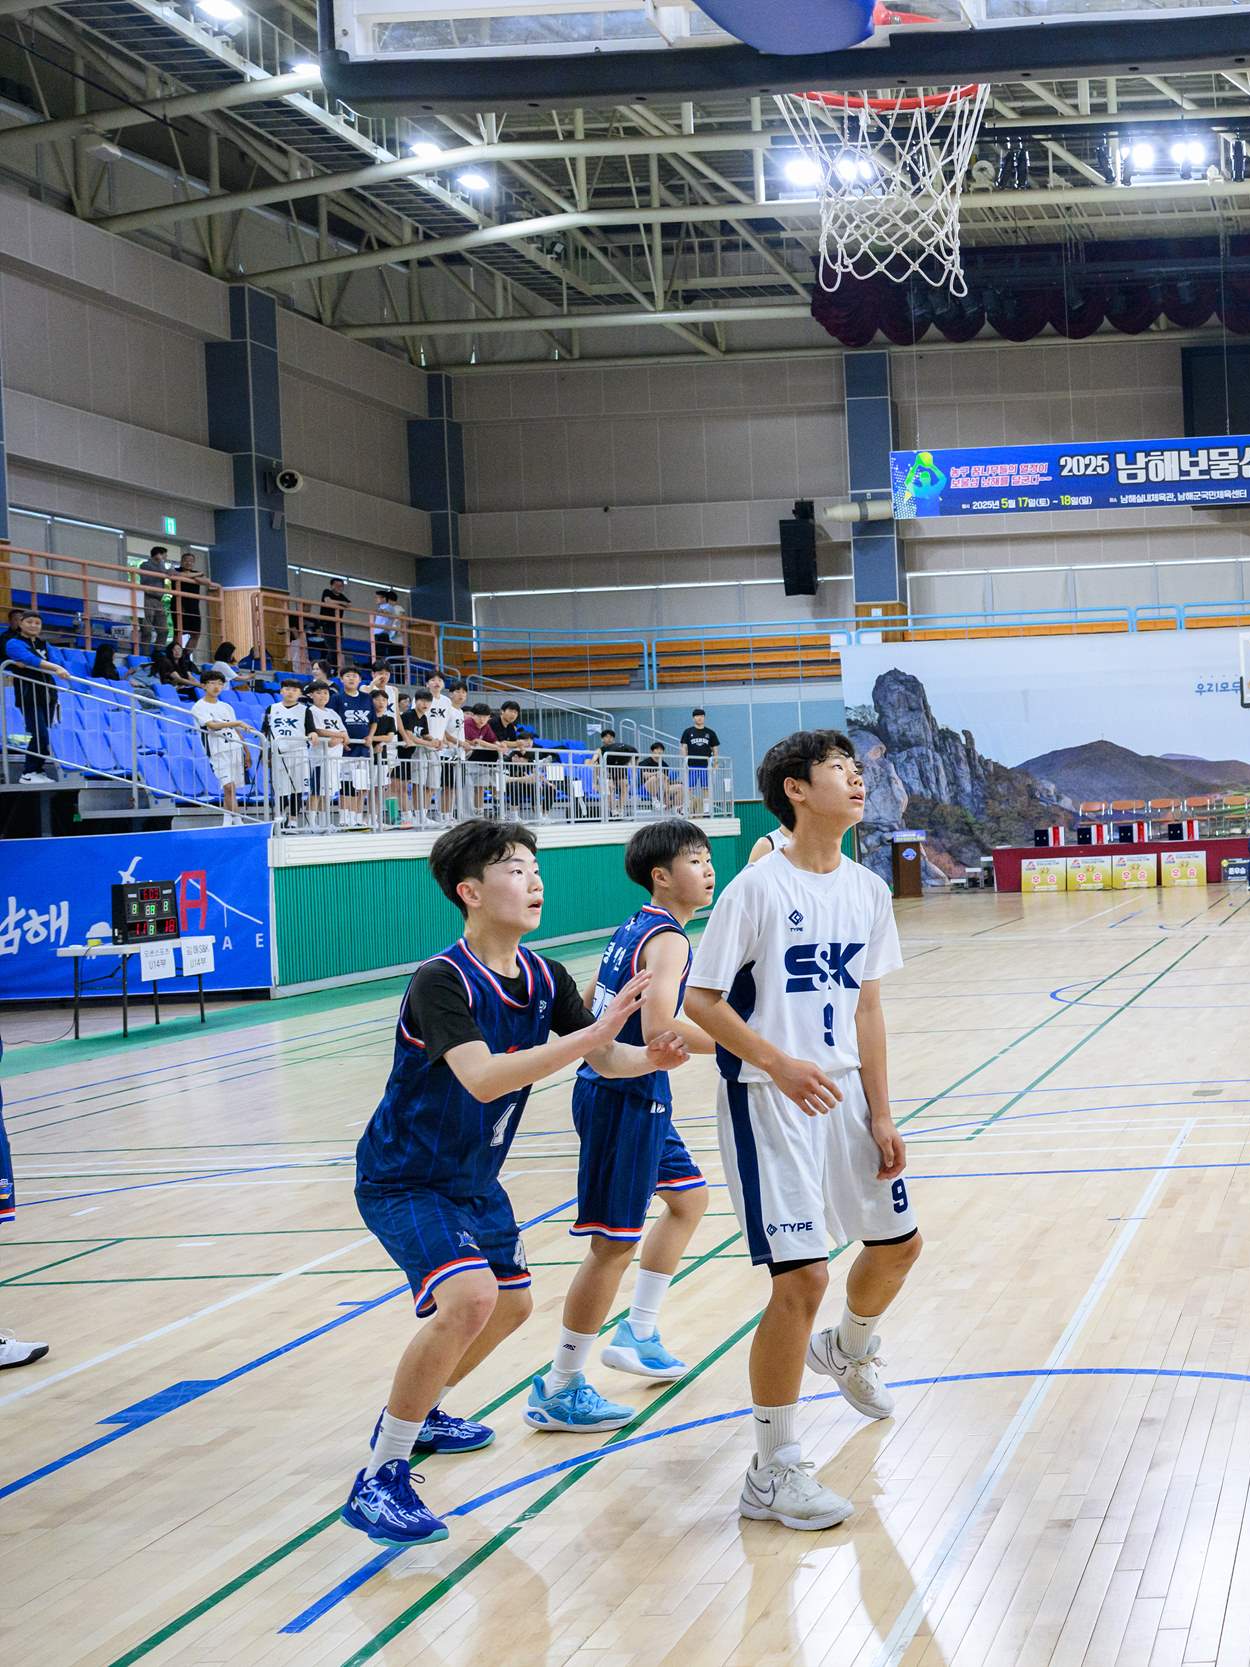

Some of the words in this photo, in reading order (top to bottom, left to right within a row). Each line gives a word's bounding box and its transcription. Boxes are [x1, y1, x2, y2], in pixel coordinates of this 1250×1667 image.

[1059, 454, 1110, 477] 2025
[890, 1177, 909, 1214] 9
[779, 1221, 813, 1234] TYPE
